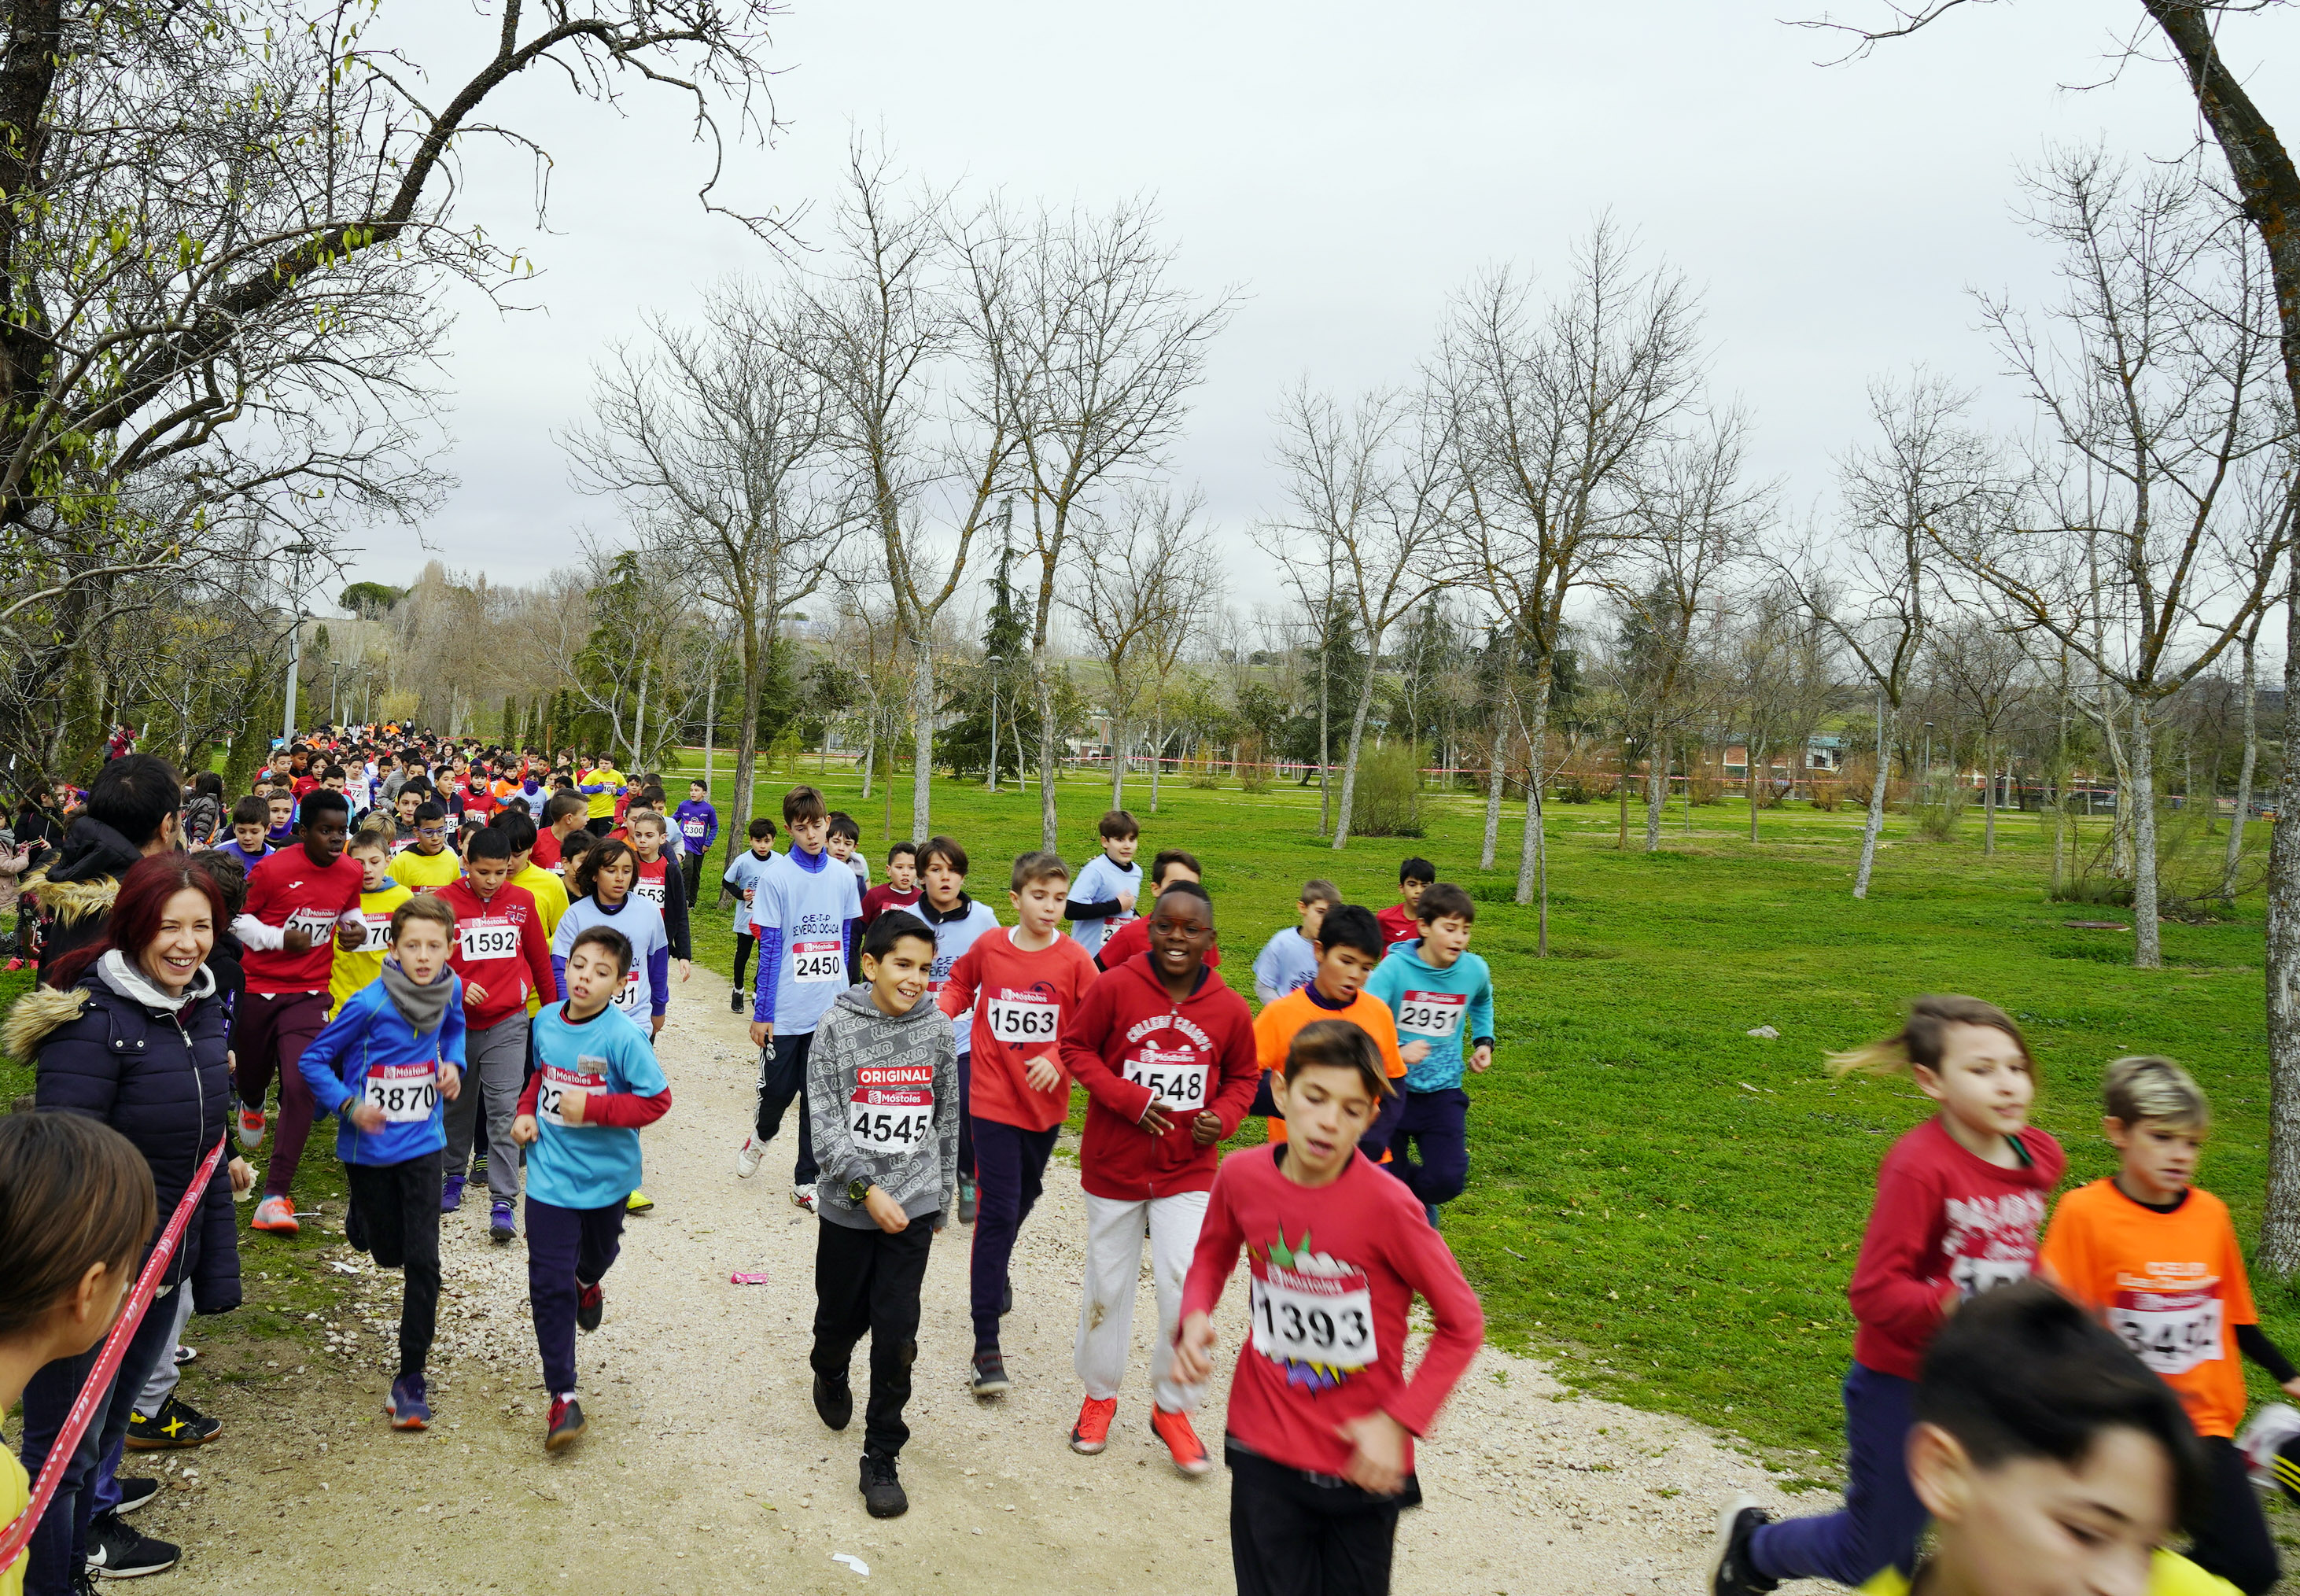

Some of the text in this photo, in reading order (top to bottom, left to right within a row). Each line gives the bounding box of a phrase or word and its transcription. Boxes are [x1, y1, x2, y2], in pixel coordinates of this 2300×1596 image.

[685, 826, 703, 835] 2300
[465, 932, 514, 953] 1592
[796, 956, 839, 976] 2450
[1012, 990, 1048, 1003] Móstoles
[992, 1008, 1054, 1034] 1563
[1401, 1007, 1459, 1030] 2951
[396, 1064, 429, 1078] Móstoles
[556, 1071, 592, 1085] Móstoles
[860, 1069, 931, 1083] ORIGINAL
[370, 1083, 435, 1111] 3870
[881, 1093, 921, 1103] Móstoles
[853, 1111, 927, 1144] 4545
[1259, 1296, 1369, 1348] 1393
